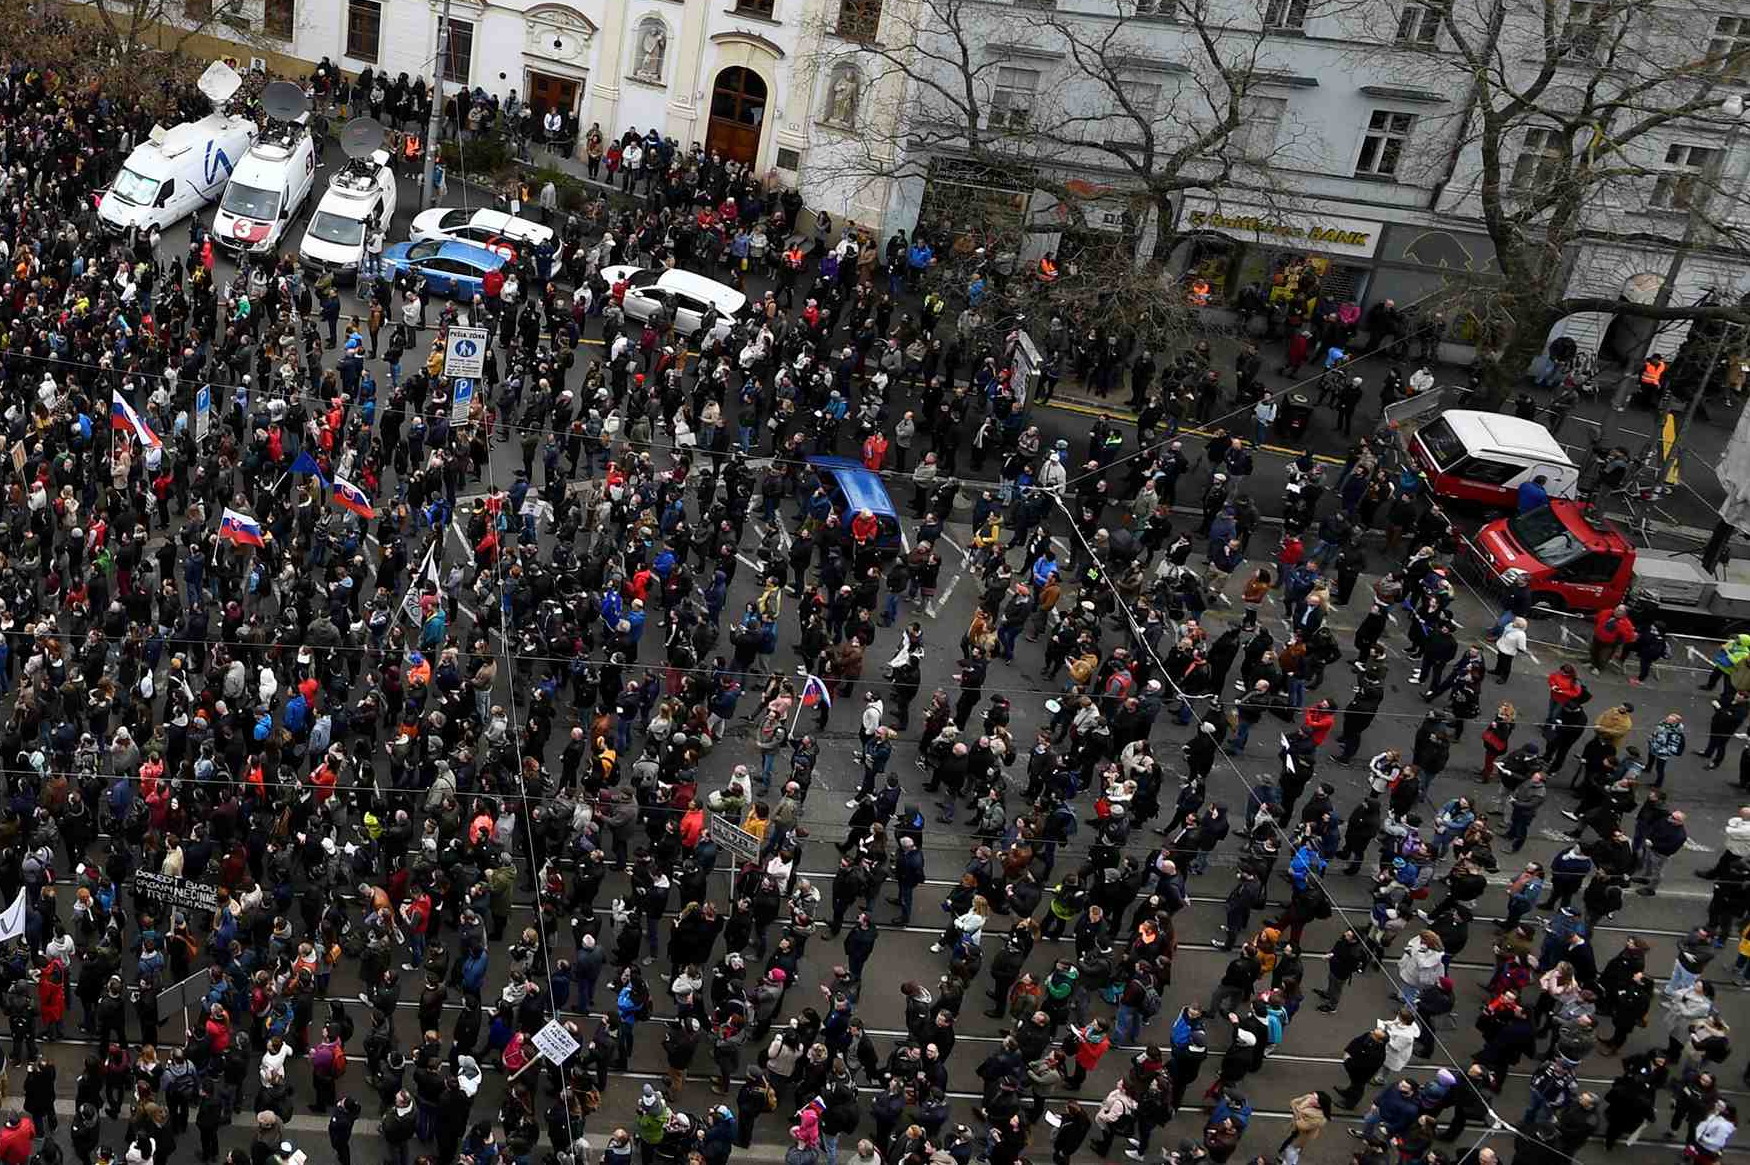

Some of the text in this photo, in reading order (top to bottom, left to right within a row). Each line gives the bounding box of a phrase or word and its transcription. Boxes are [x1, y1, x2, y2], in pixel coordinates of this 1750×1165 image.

[236, 219, 252, 238] 3
[1308, 226, 1371, 247] BANK
[460, 381, 467, 394] P
